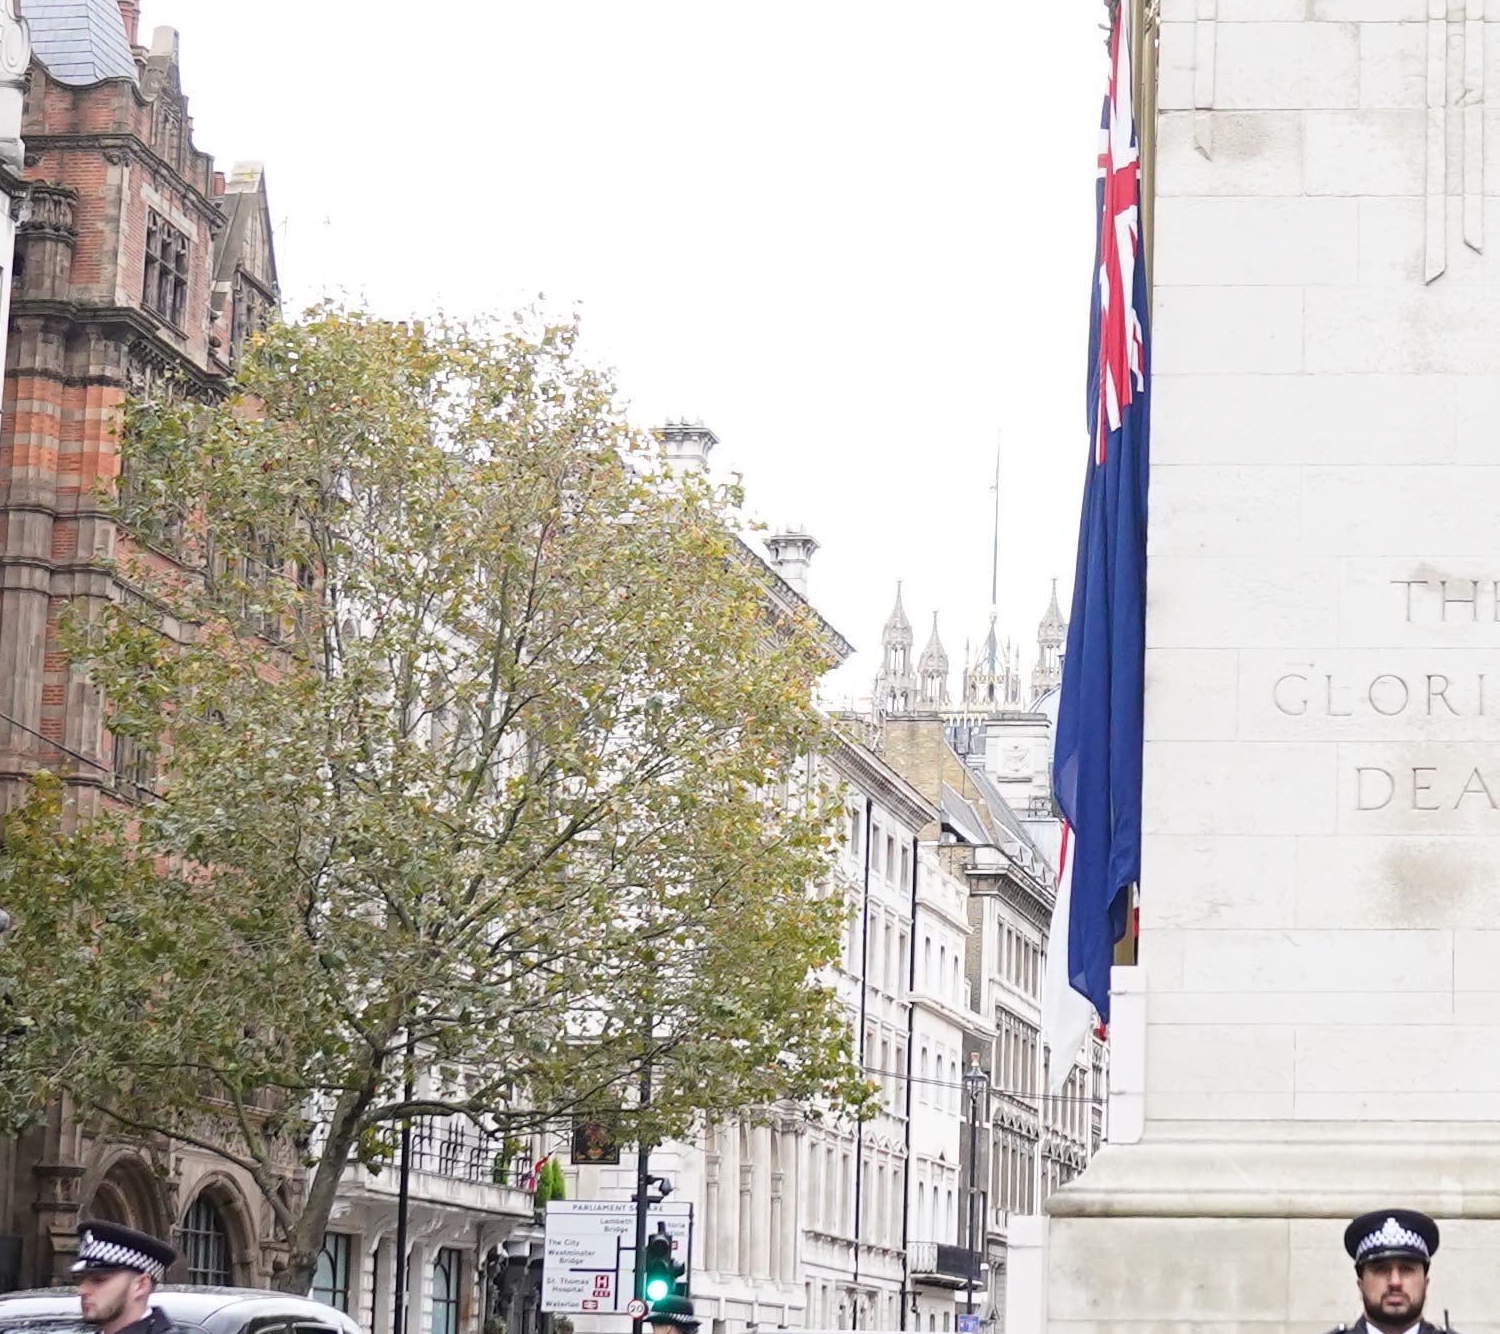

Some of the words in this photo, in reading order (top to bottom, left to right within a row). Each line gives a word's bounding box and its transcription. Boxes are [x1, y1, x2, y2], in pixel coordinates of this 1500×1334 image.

[604, 1225, 628, 1233] Bridge
[564, 1239, 580, 1247] City
[559, 1257, 584, 1265] Bridge
[630, 1304, 644, 1313] 20
